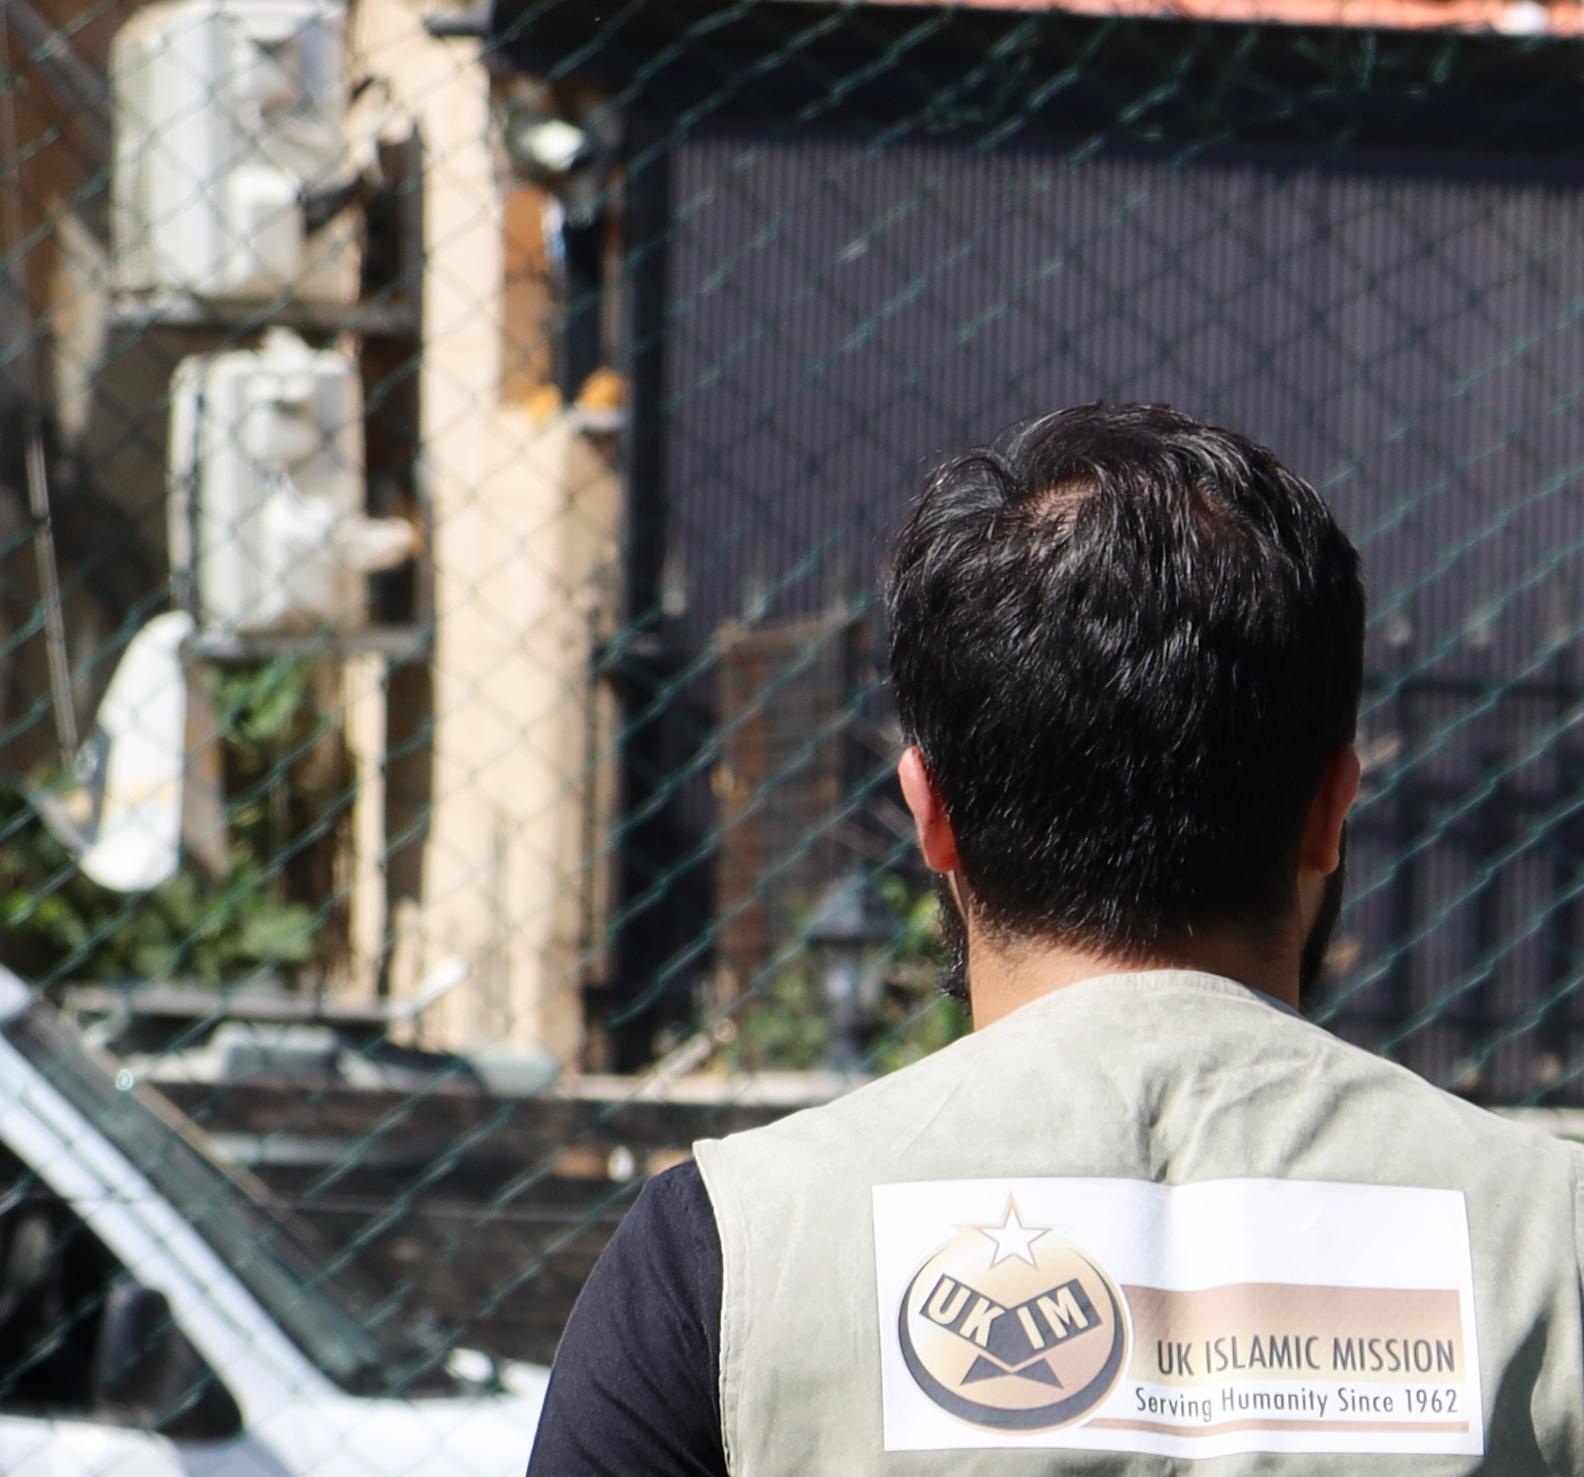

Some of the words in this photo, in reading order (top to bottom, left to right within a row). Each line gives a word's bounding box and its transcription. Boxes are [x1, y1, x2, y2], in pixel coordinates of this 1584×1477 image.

[927, 1277, 1089, 1350] UKIM
[1157, 1340, 1193, 1376] UK
[1206, 1334, 1320, 1374] ISLAMIC
[1332, 1339, 1456, 1373] MISSION
[1136, 1388, 1212, 1422] Serving
[1222, 1388, 1328, 1418] Humanity
[1338, 1388, 1393, 1413] Since
[1405, 1389, 1458, 1414] 1962
